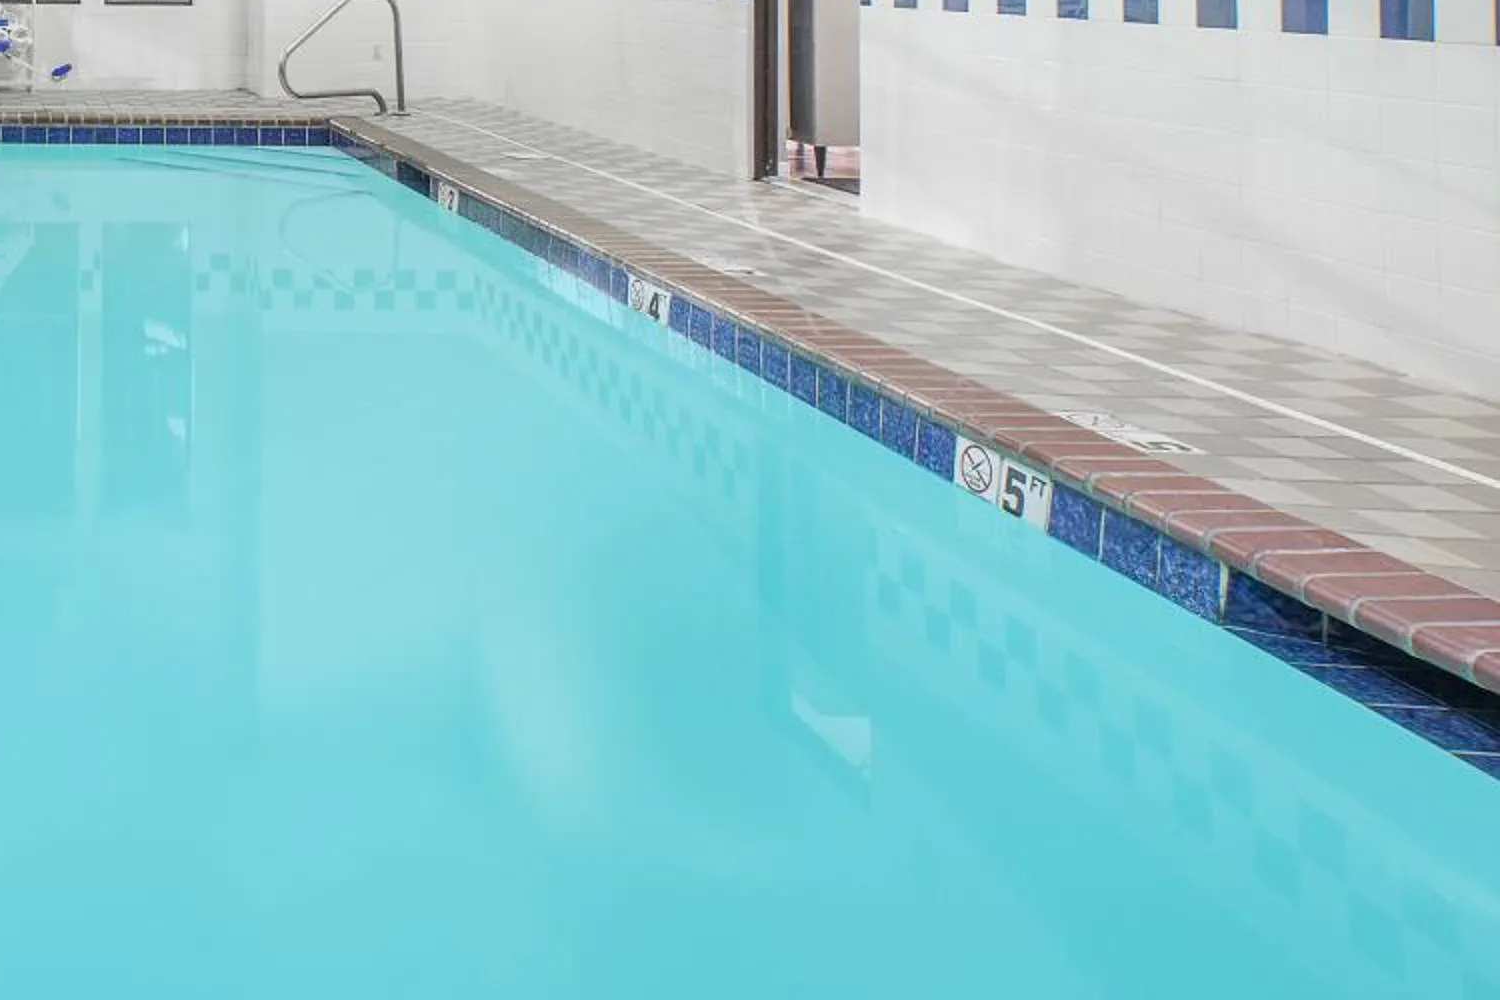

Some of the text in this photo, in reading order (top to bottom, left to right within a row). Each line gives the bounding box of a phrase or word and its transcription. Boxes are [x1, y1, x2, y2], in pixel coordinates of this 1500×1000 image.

[647, 291, 660, 320] 4
[1002, 466, 1047, 518] 5 FT
